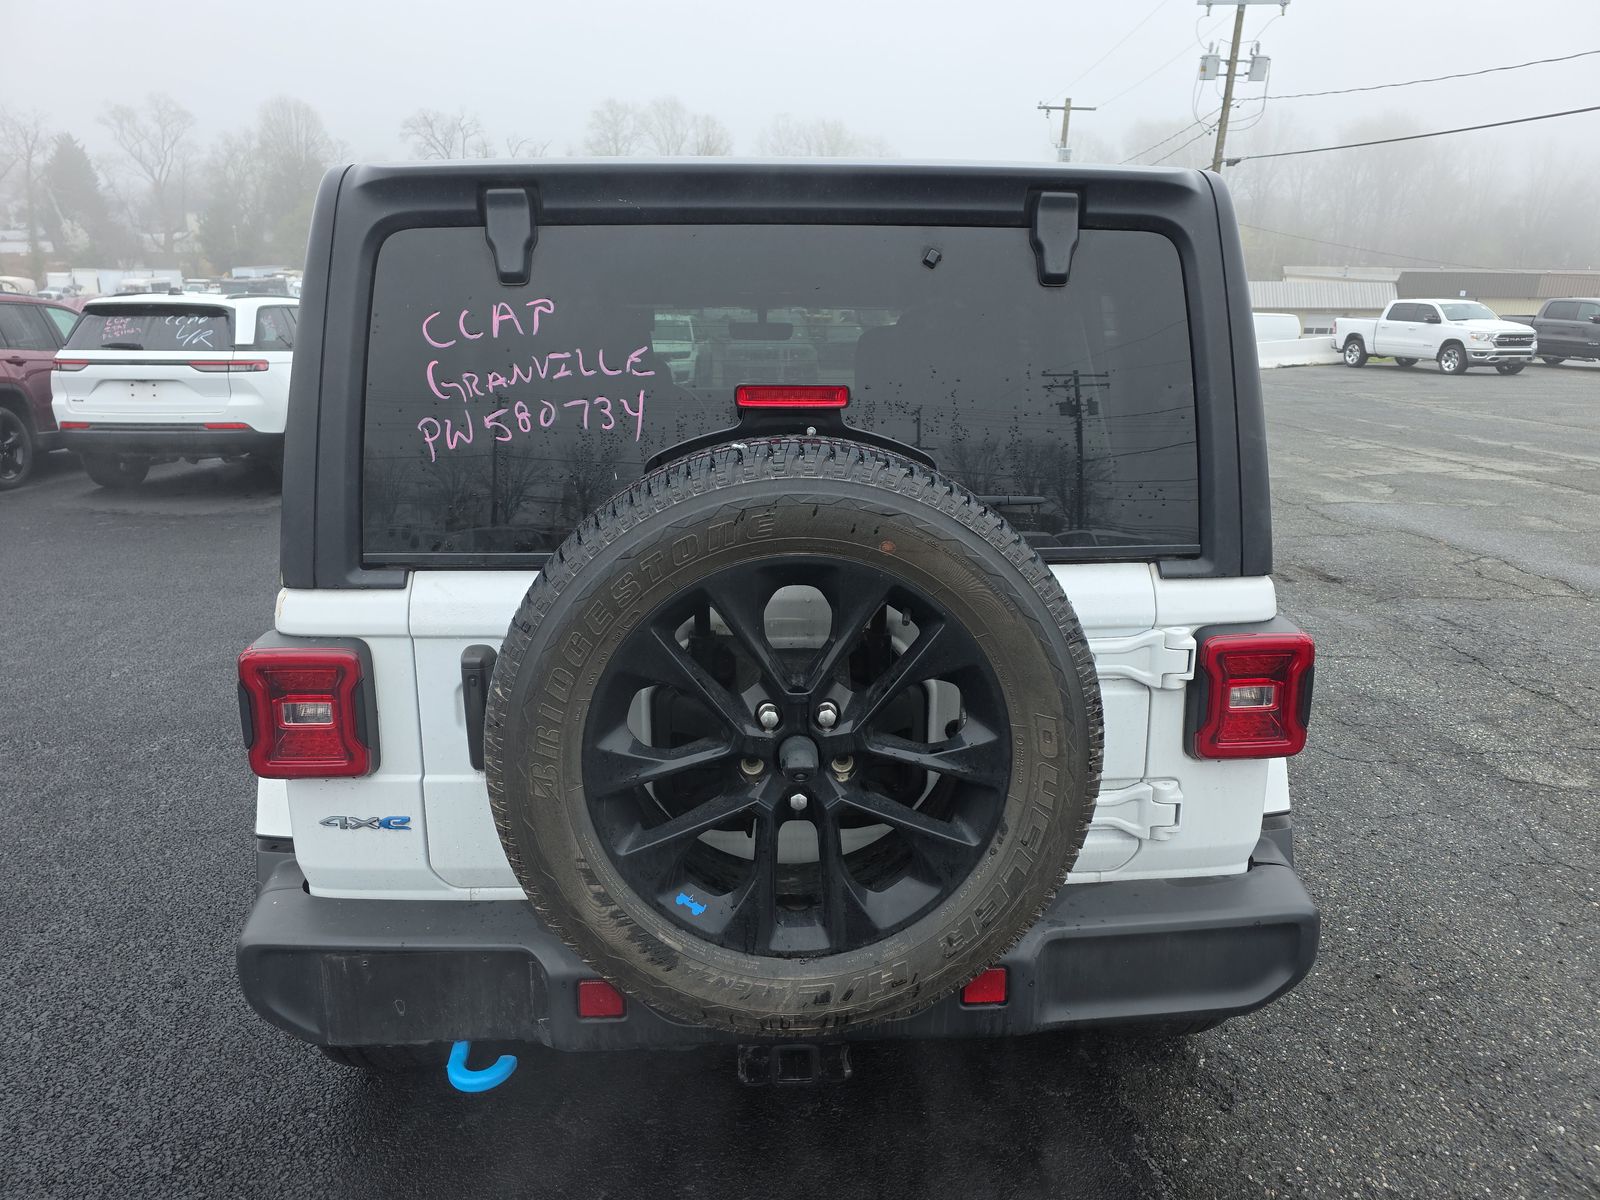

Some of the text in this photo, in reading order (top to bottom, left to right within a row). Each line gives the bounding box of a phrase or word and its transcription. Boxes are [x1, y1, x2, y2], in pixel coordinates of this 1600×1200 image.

[422, 298, 555, 348] CCAP
[426, 346, 656, 402] GRANVILLE
[529, 511, 778, 803] BRIDGESTONE
[937, 712, 1060, 960] DUELER
